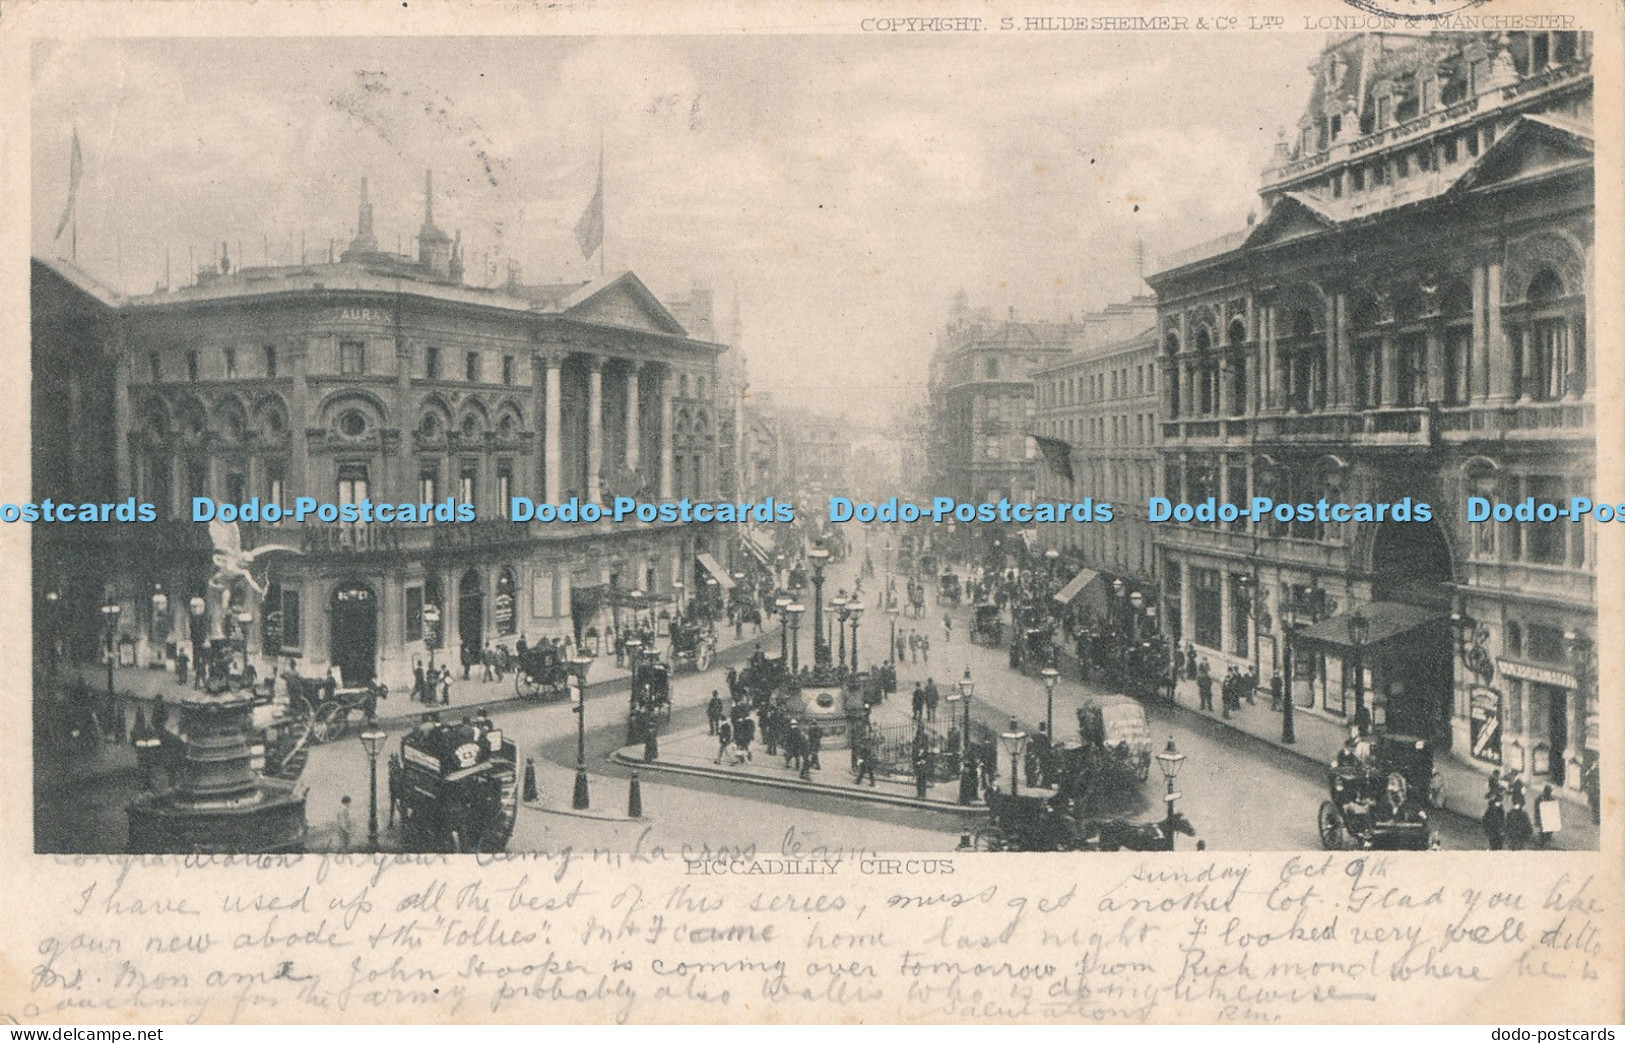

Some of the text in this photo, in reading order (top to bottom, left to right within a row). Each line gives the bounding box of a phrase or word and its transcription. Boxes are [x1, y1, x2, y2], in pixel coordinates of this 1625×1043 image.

[860, 16, 987, 31] COPYRIGHT.
[1196, 16, 1209, 30] &
[1303, 15, 1397, 30] LONDON
[684, 859, 955, 876] PICCADILLY CIRCUS
[105, 887, 201, 915] have
[222, 885, 312, 913] used
[328, 885, 373, 930] up
[397, 879, 447, 912] all
[665, 884, 725, 912] this
[1461, 886, 1526, 920] you
[1543, 873, 1605, 913] like
[145, 932, 213, 954] new
[233, 915, 352, 949] abode
[1218, 910, 1339, 948] looked
[651, 957, 787, 989] coming
[806, 960, 878, 978] over
[899, 950, 1057, 980] tomorrow
